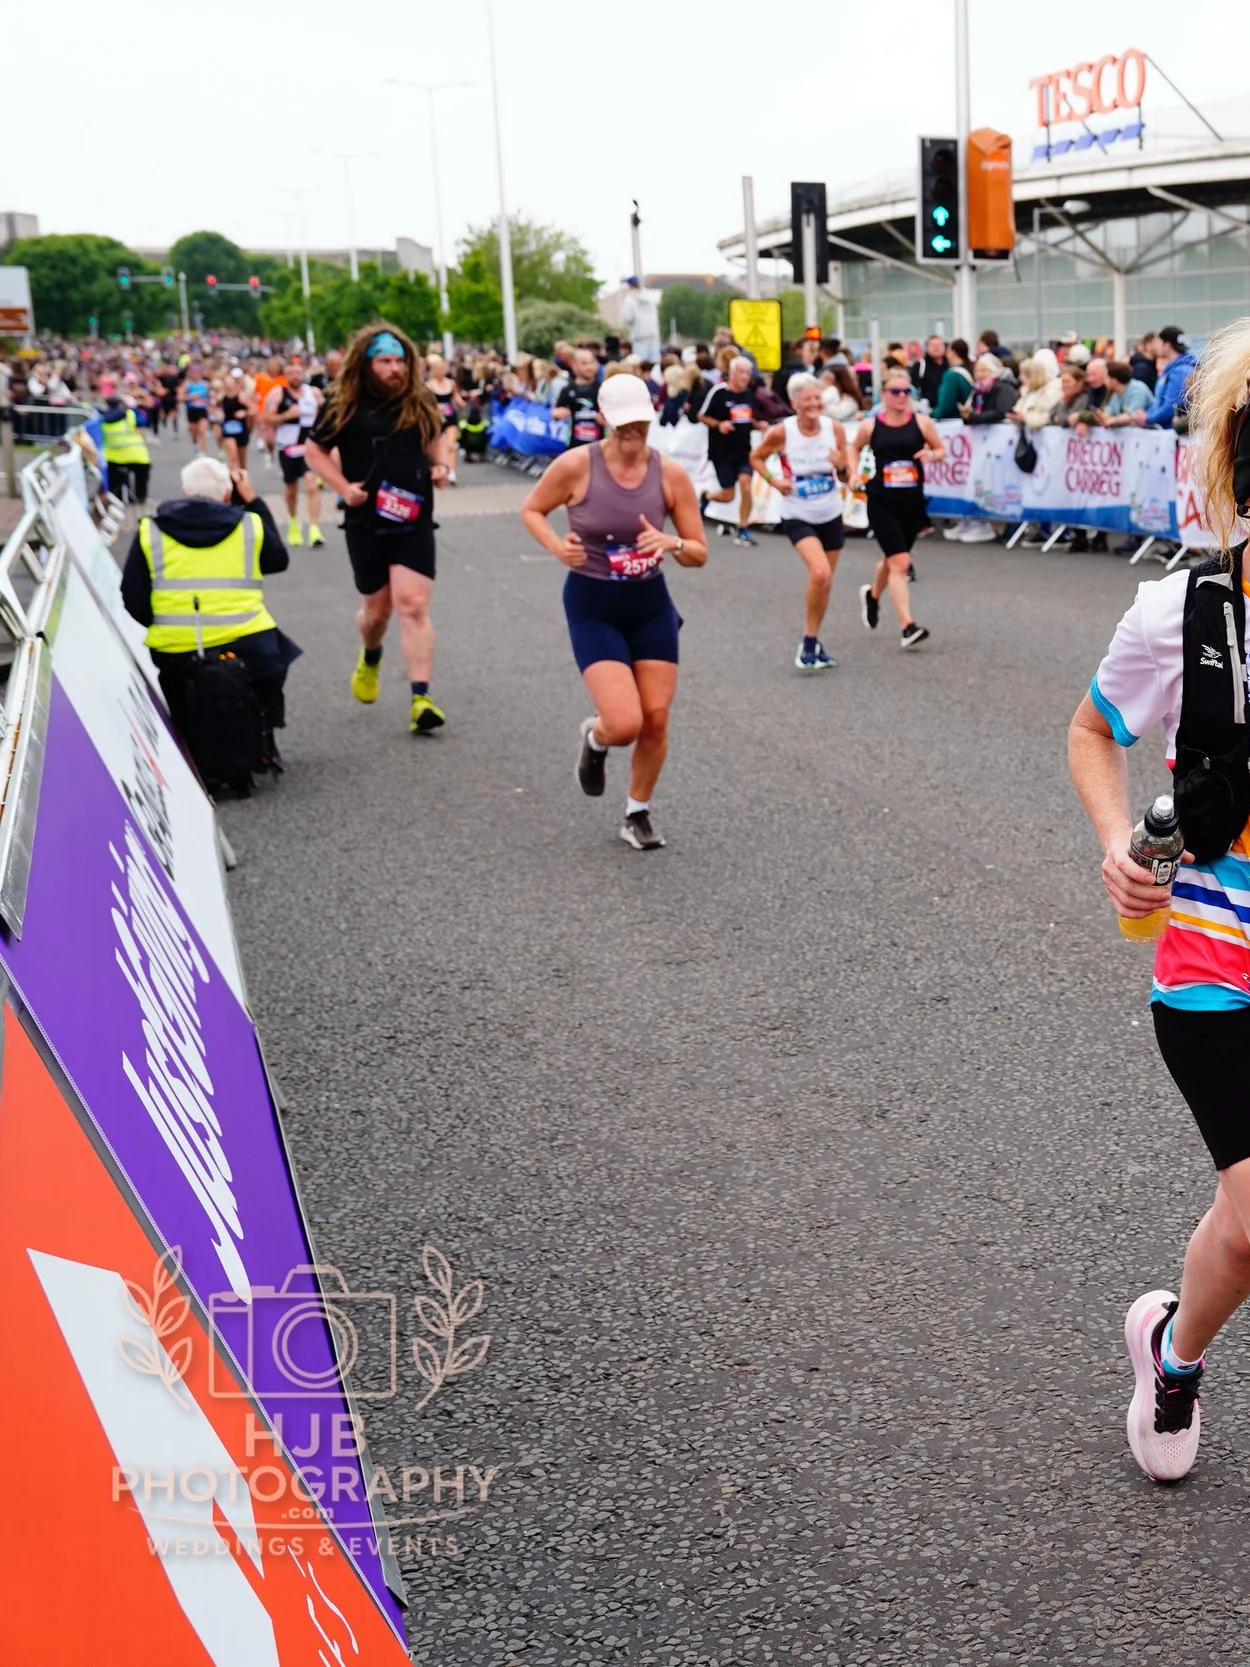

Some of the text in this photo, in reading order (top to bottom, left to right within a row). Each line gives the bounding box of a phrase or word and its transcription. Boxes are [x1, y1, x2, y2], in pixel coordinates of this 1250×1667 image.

[1029, 48, 1146, 128] TESCO
[1066, 437, 1122, 467] BRECON
[1065, 467, 1120, 497] CARREG
